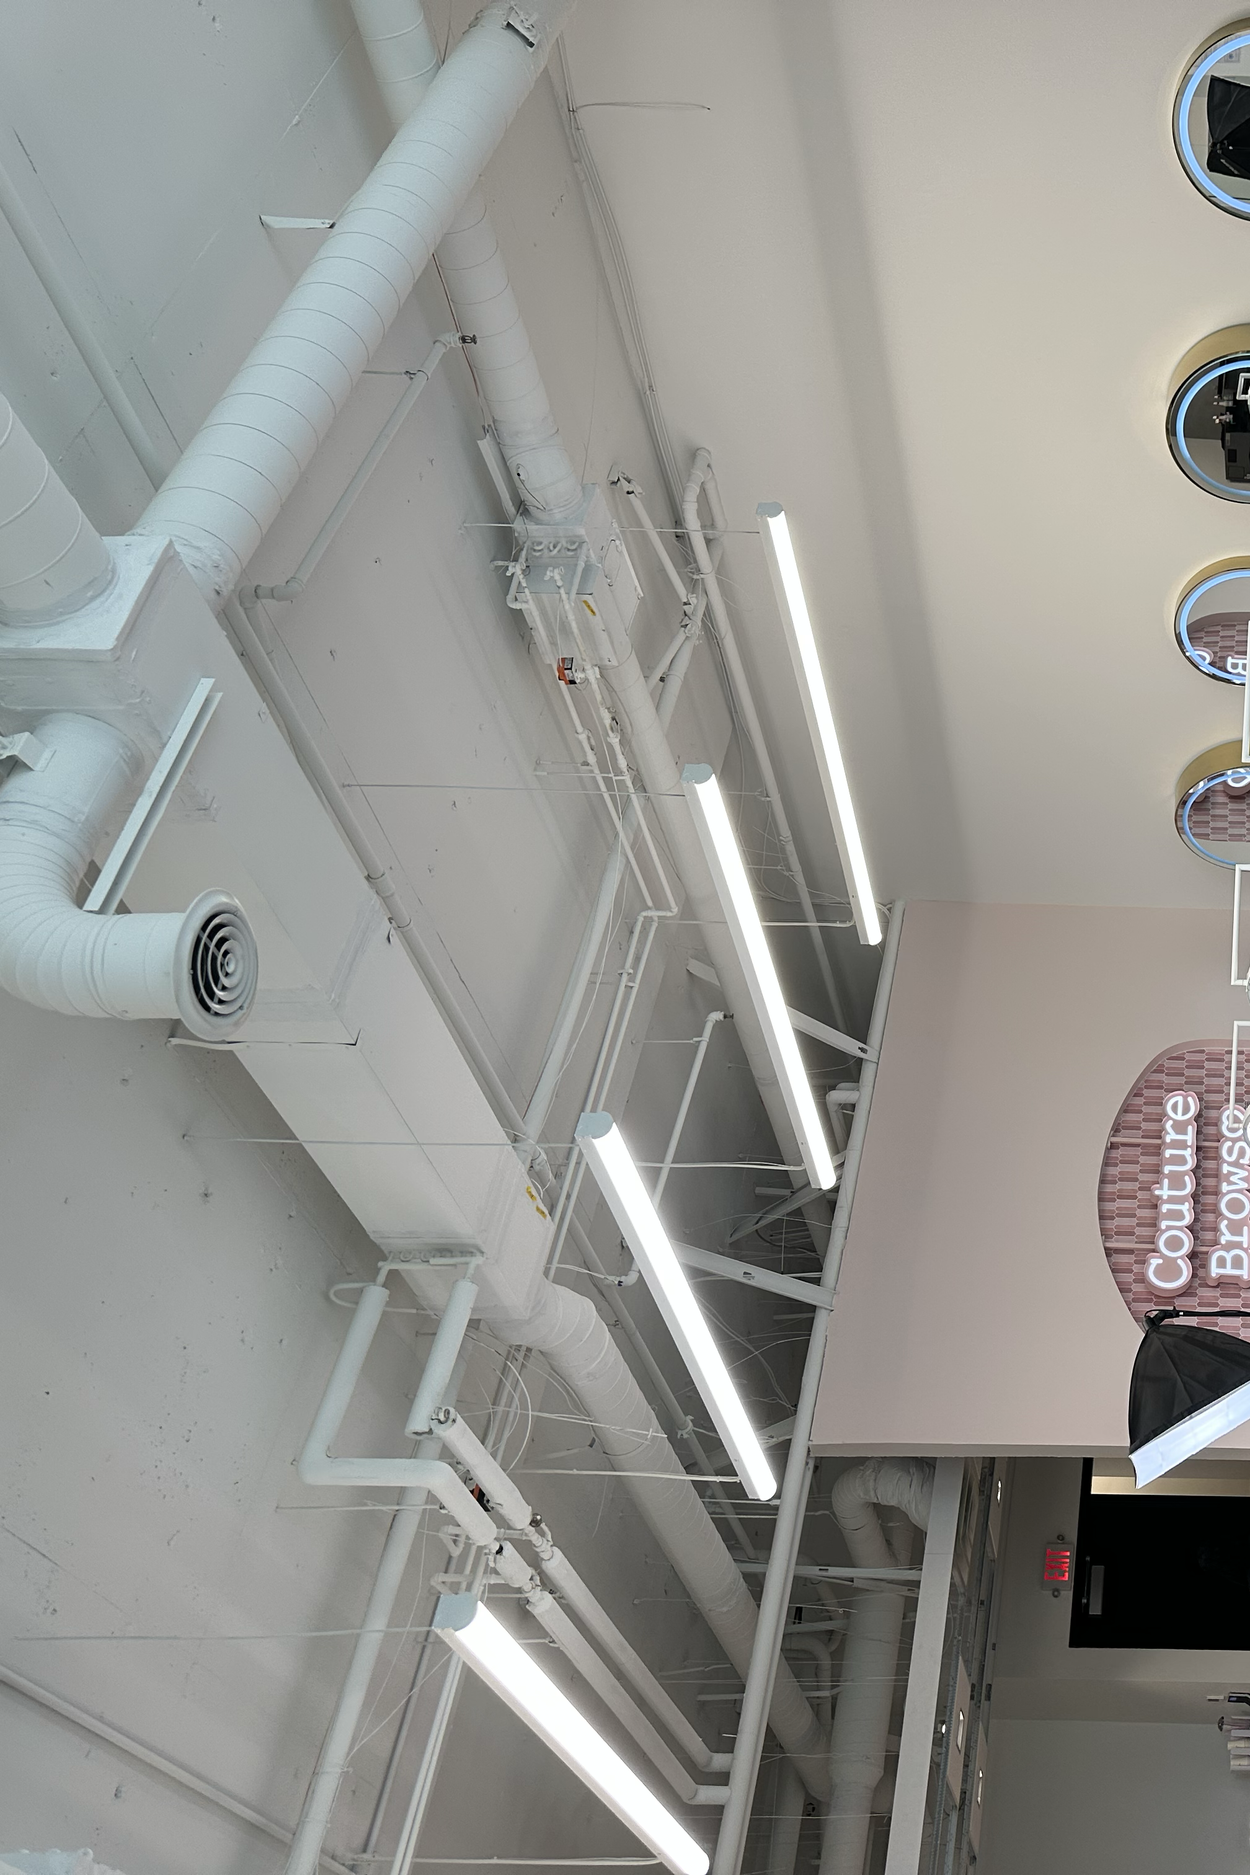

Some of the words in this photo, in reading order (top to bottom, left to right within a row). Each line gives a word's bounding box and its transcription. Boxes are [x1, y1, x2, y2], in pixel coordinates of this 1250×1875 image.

[1148, 1096, 1195, 1288] Couture
[1210, 1140, 1250, 1280] Brows
[1044, 1548, 1070, 1580] EXIT
